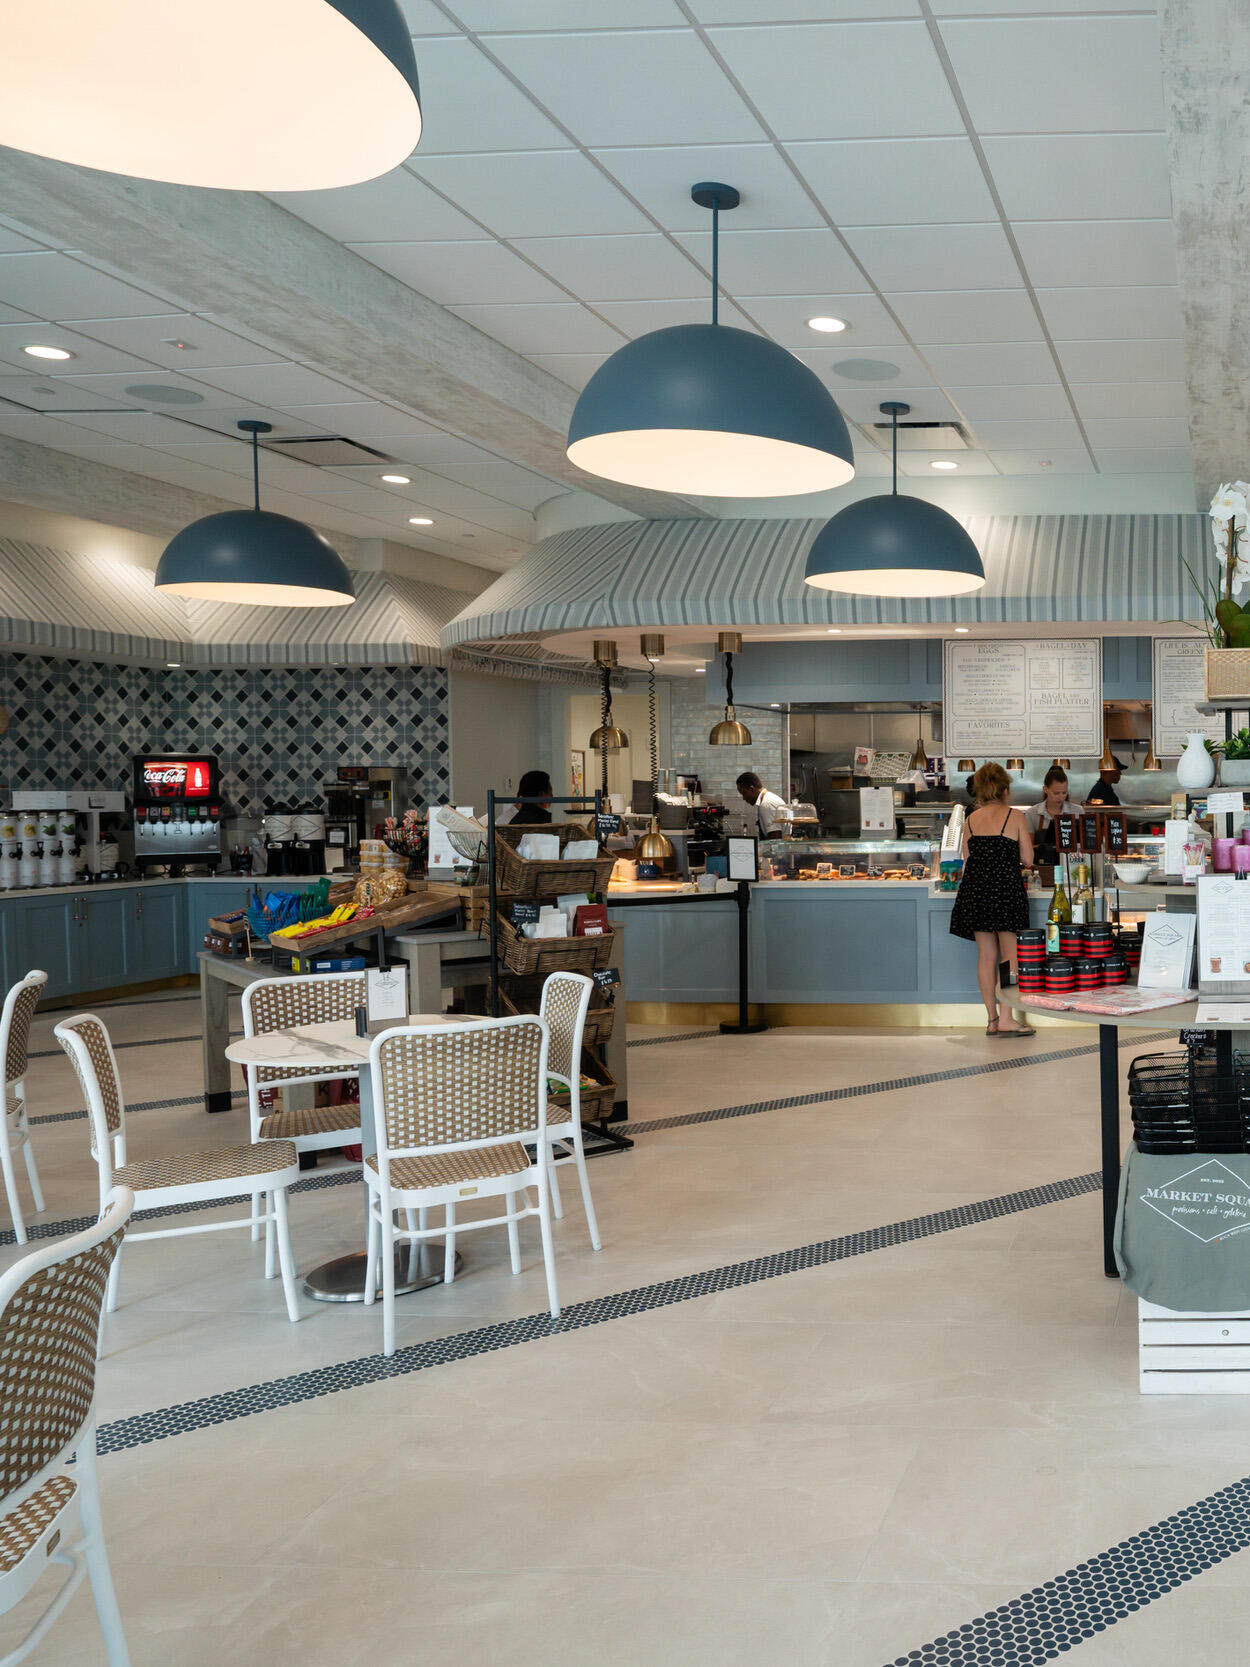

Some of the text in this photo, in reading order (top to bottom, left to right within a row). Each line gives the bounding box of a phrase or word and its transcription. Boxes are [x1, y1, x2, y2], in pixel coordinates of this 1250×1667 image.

[978, 647, 1000, 655] EGGS
[968, 721, 1010, 729] FAVORITES
[144, 768, 187, 783] Coca-Cola
[1145, 1187, 1213, 1203] MARKET
